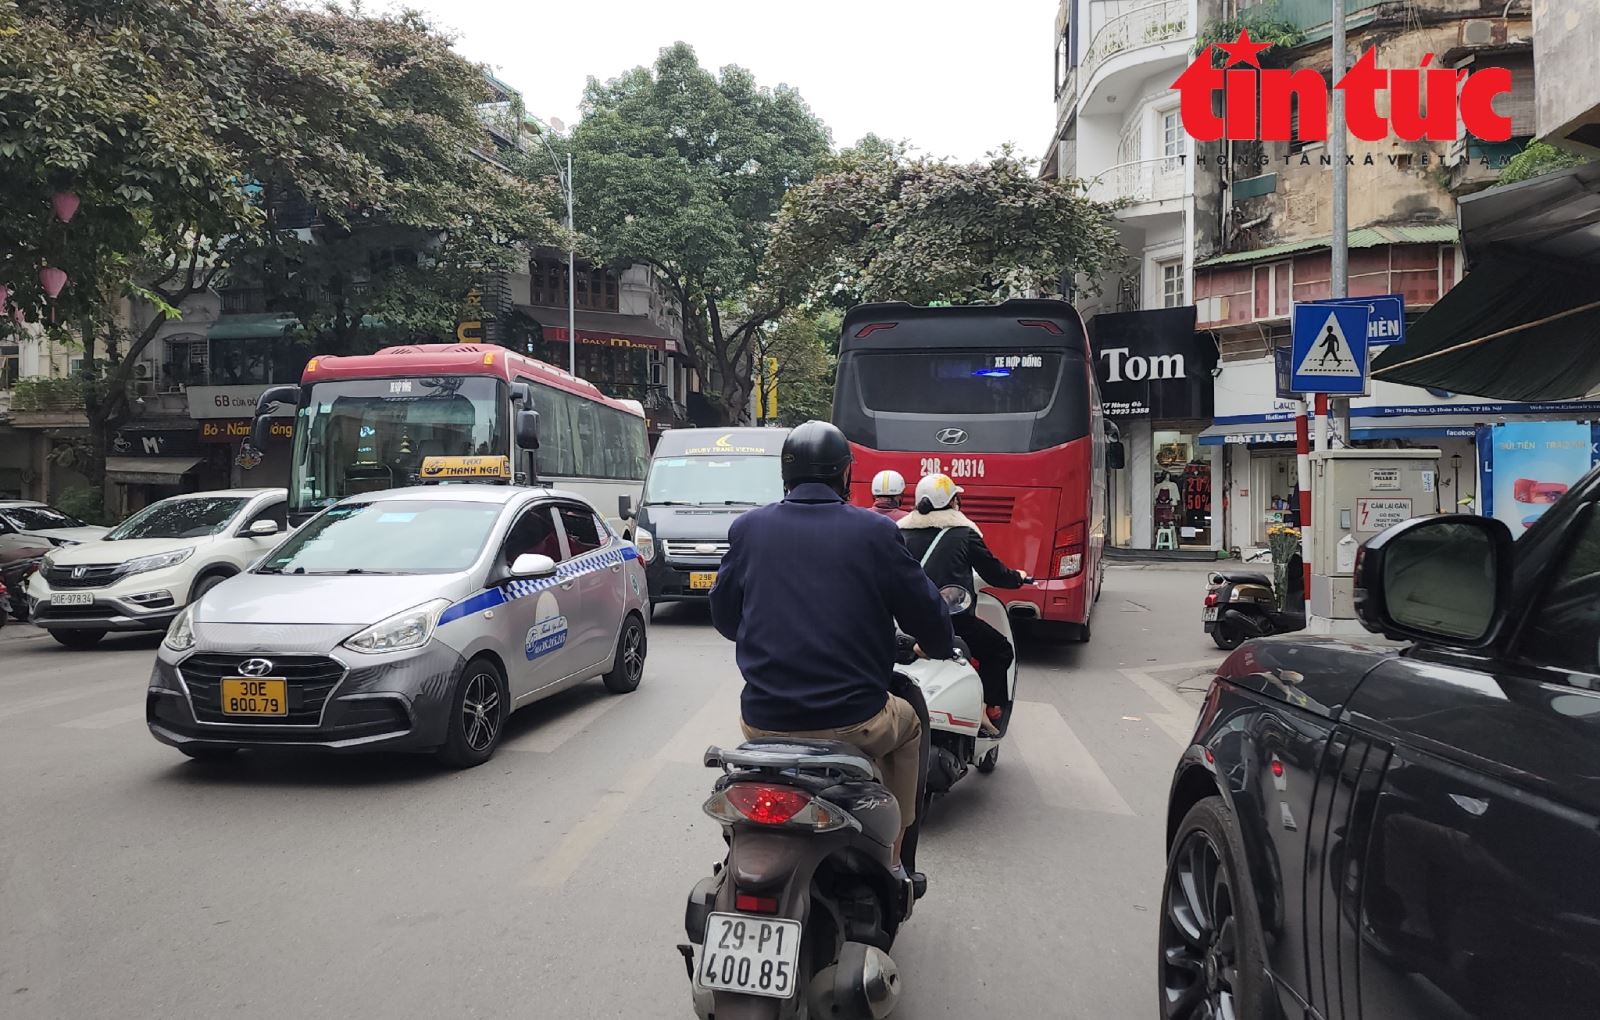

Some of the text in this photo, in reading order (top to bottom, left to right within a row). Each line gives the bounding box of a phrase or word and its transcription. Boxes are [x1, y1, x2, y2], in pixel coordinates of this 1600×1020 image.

[1368, 317, 1400, 338] HÈN
[994, 356, 1004, 368] XE
[1006, 355, 1020, 370] HỢP
[1100, 347, 1187, 383] Tom
[214, 395, 229, 407] 6B
[446, 466, 476, 475] THANH
[479, 466, 499, 475] NGA
[951, 458, 985, 478] 20314
[239, 681, 267, 697] 30E
[230, 697, 279, 713] 800.79
[718, 919, 785, 956] 29-P1
[705, 953, 790, 992] 400.85
